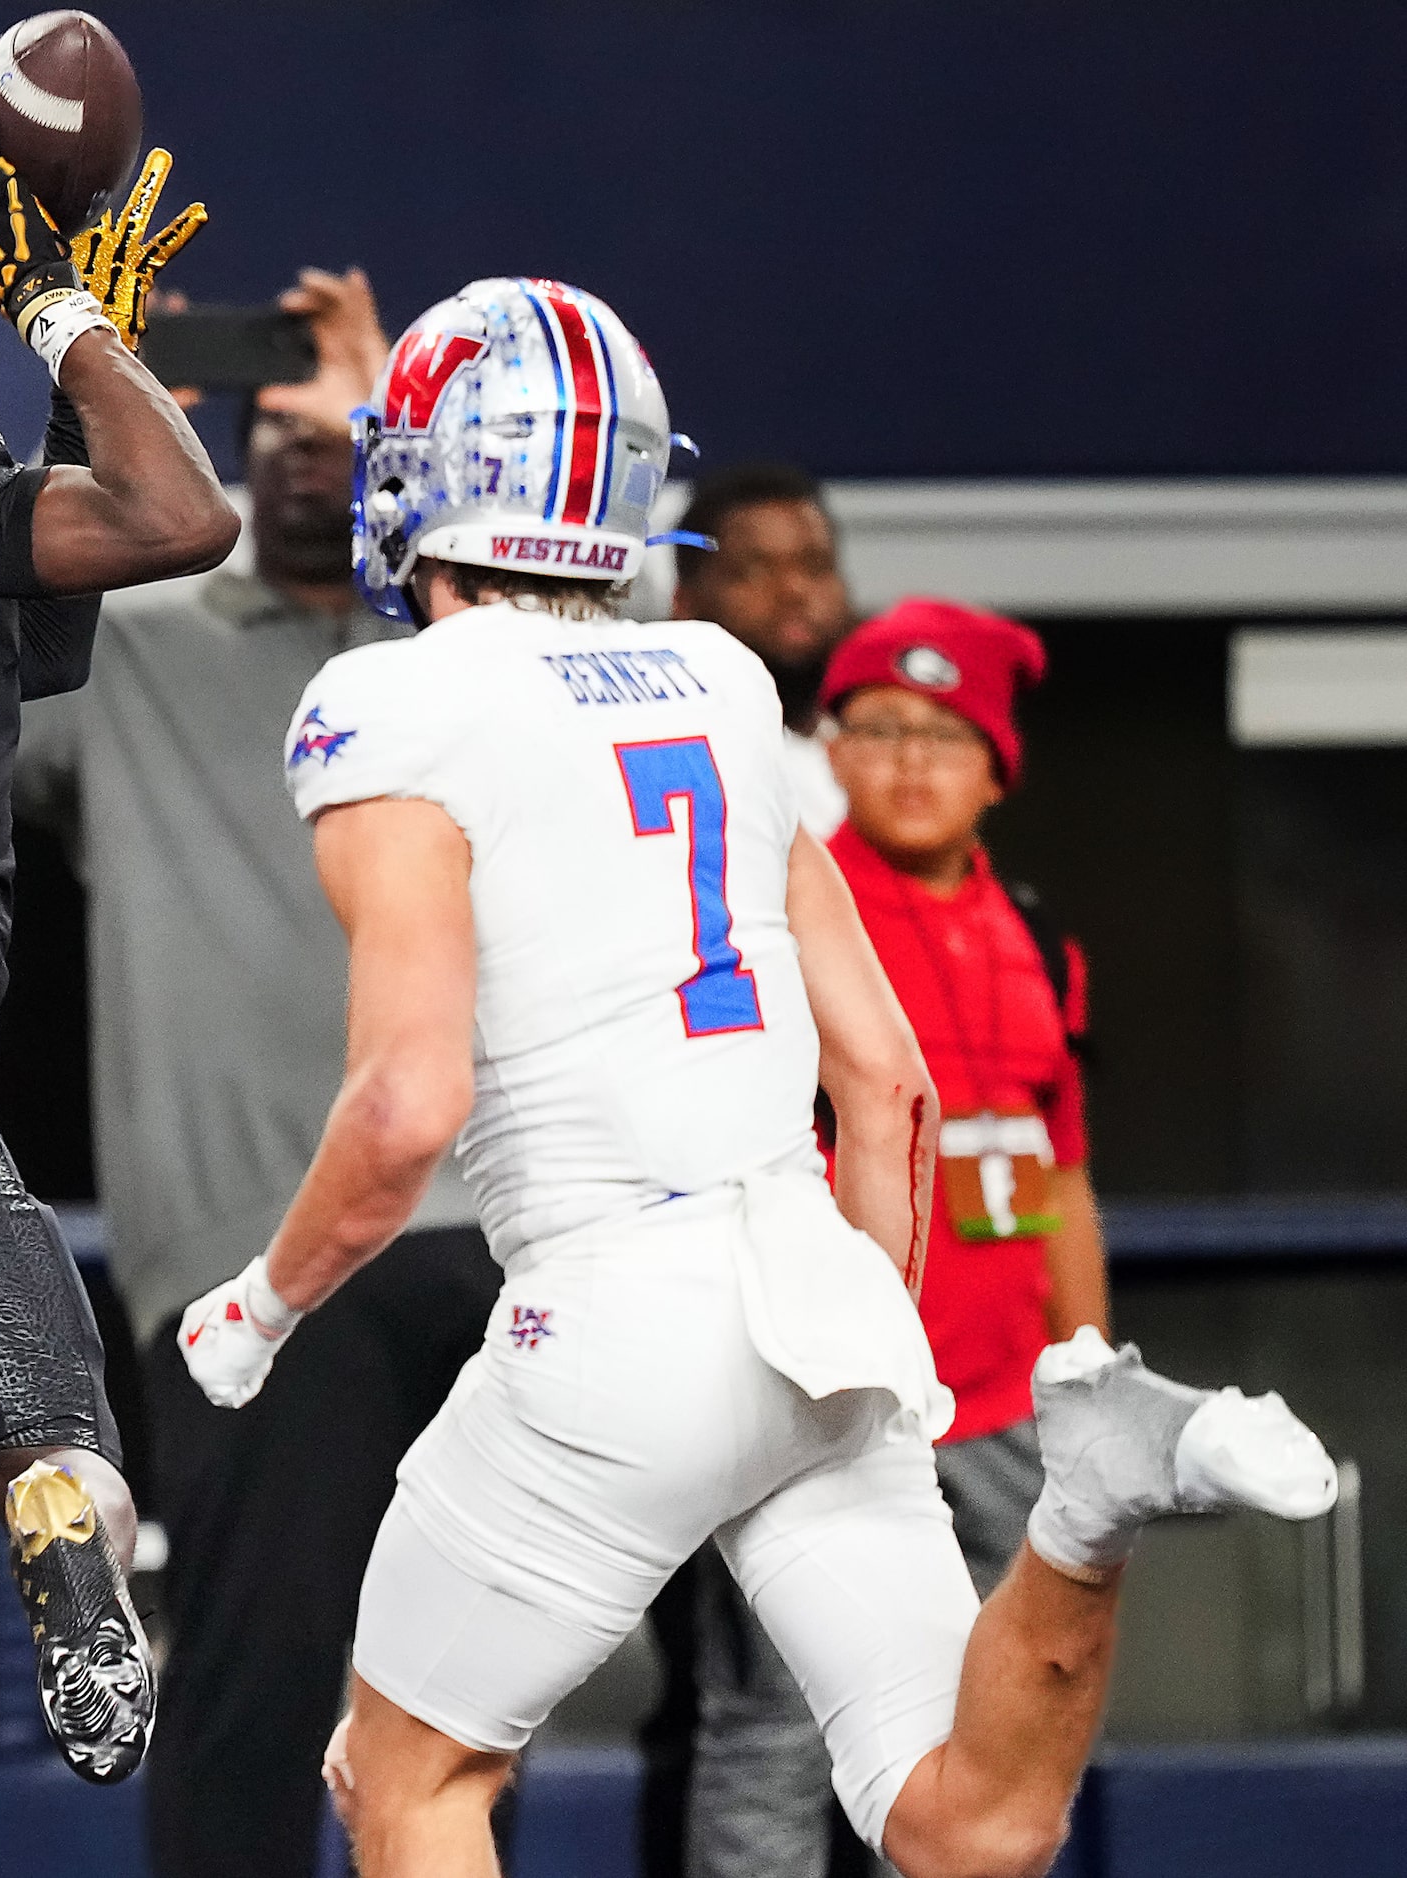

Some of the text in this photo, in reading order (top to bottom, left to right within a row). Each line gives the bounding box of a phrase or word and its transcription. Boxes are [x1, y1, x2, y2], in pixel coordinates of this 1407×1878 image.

[381, 331, 489, 436] W
[485, 457, 502, 493] 7
[491, 536, 629, 571] WESTLAKE
[539, 649, 709, 705] BENNETT
[613, 735, 765, 1039] 7
